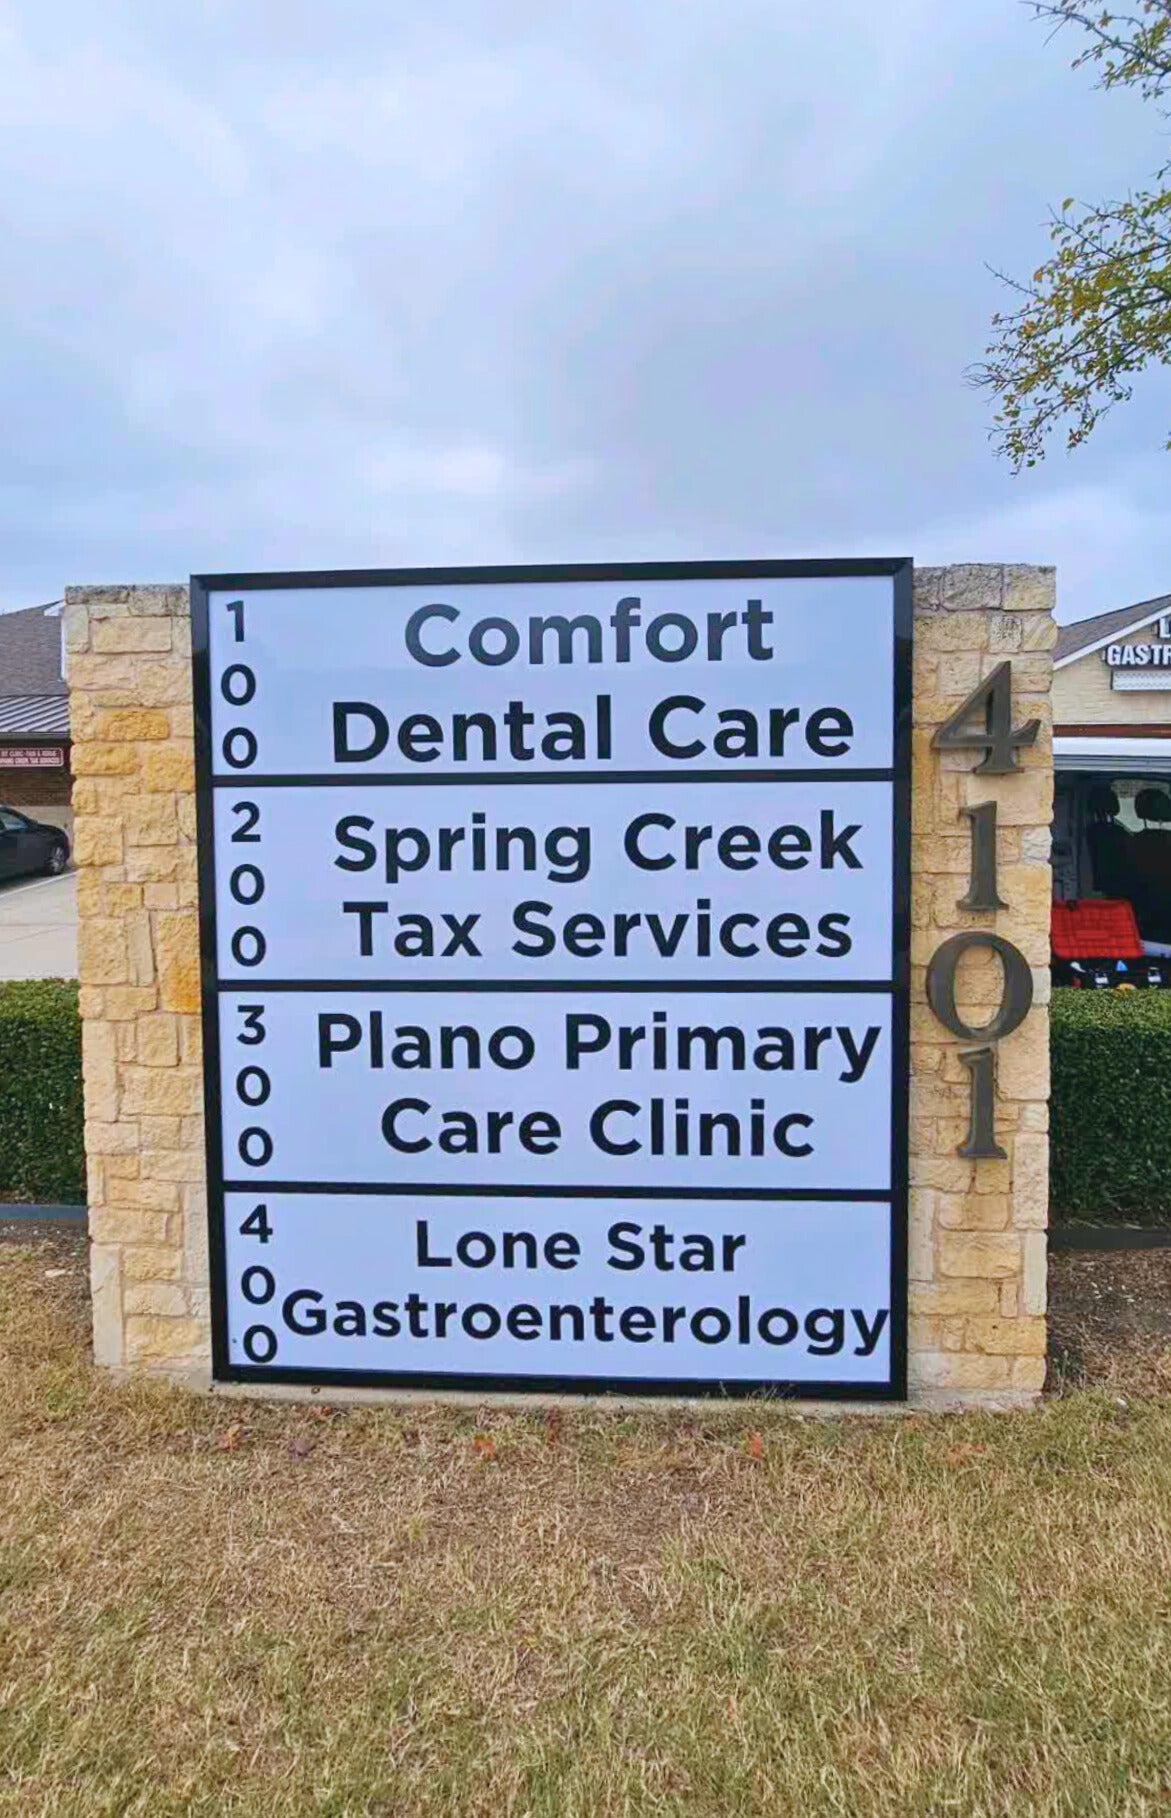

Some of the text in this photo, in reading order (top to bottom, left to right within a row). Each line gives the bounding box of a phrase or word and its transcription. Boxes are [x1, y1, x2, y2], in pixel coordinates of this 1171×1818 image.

[405, 597, 773, 667] Comfort
[333, 695, 853, 762] Dental Care
[334, 810, 863, 883] Spring Creek
[343, 900, 851, 958] Tax Services
[318, 1011, 881, 1083] Plano Primary
[382, 1098, 814, 1157] Care Clinic
[417, 1220, 746, 1272] Lone Star
[282, 1289, 889, 1356] Gastroenterology
